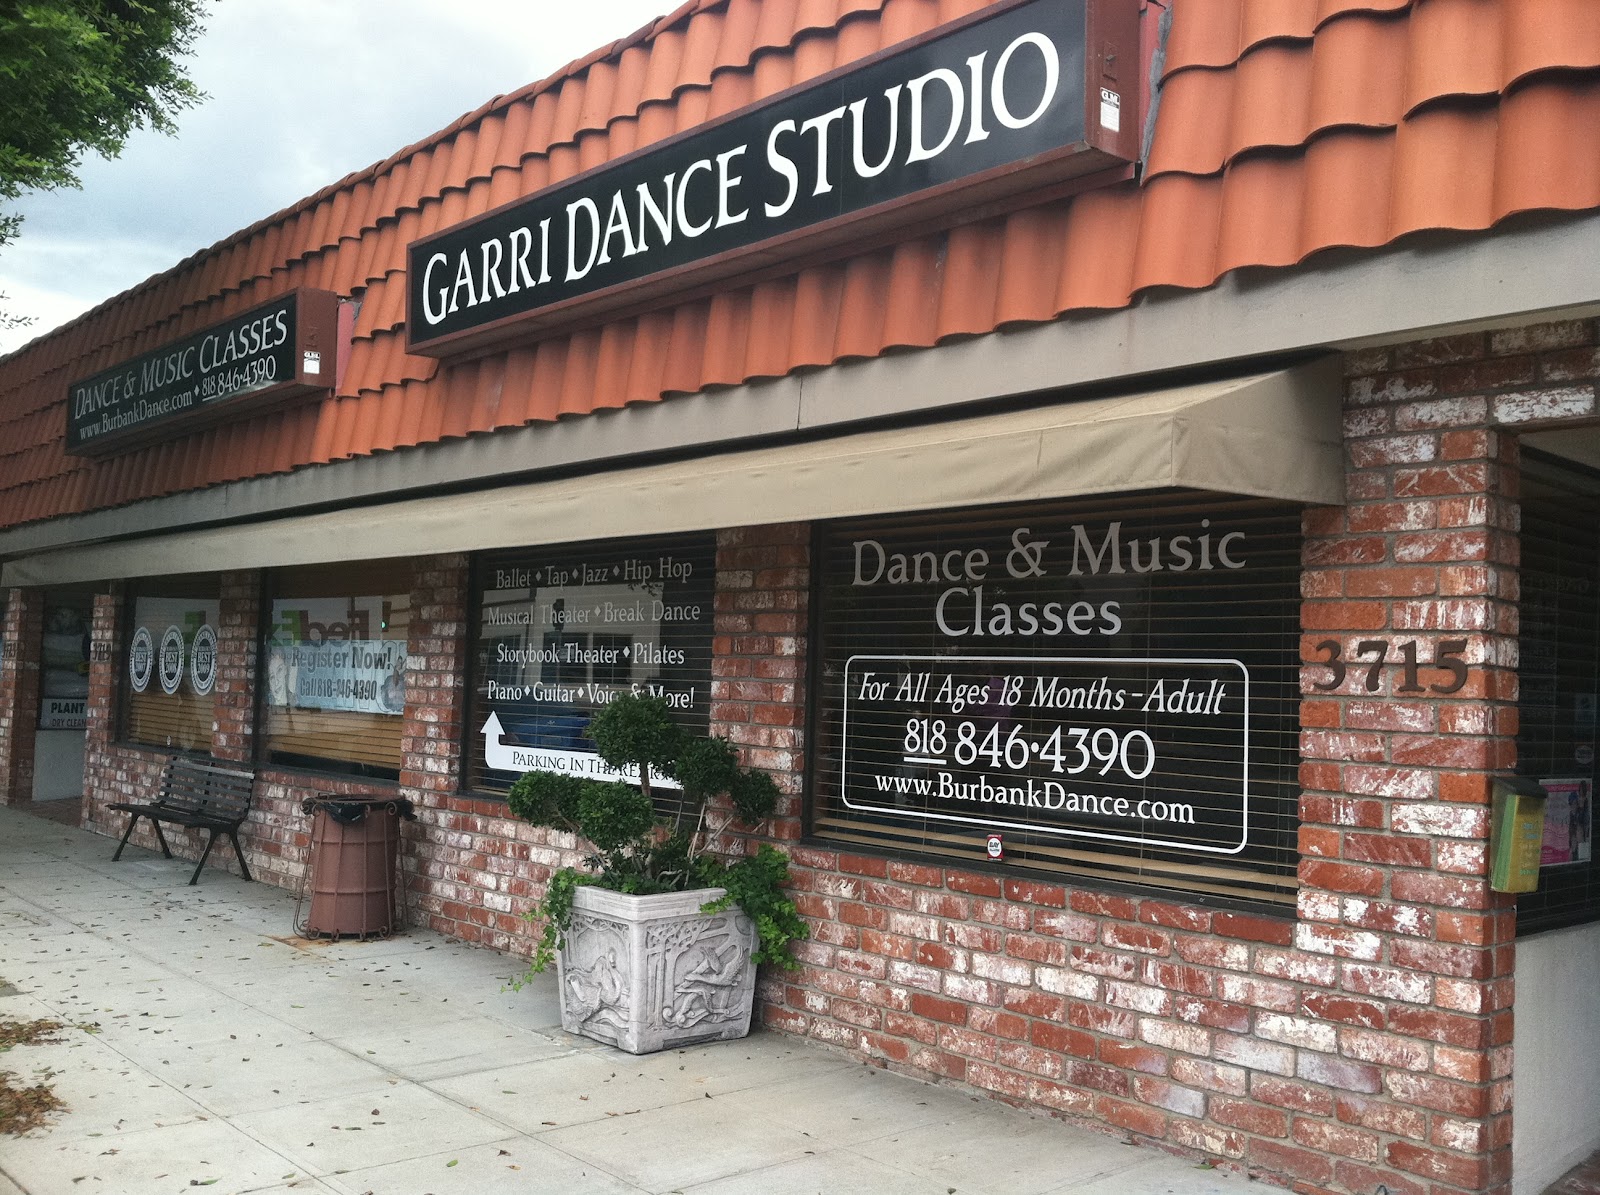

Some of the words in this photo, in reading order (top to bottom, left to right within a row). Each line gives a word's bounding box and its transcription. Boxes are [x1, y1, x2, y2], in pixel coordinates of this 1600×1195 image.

[421, 217, 552, 326] GARRI
[563, 144, 749, 283] DANCE
[764, 31, 1060, 219] STUDIO
[75, 373, 122, 420] DANCE
[123, 371, 137, 399] &
[139, 346, 195, 396] MUSIC
[199, 309, 288, 373] CLASSES
[79, 389, 193, 440] www.BurbankDance.com
[202, 376, 217, 401] 818
[852, 539, 990, 586] Dance
[1006, 527, 1050, 578] &
[1069, 519, 1247, 576] Music
[495, 568, 532, 589] Ballet
[545, 564, 569, 590] Tap
[582, 563, 609, 587] Jazz
[623, 559, 652, 585] Hip
[658, 556, 693, 584] Hop
[487, 605, 534, 625] Musical
[540, 604, 591, 624] Theater
[603, 601, 645, 623] Break
[651, 600, 701, 621] Dance
[935, 586, 1123, 637] Classes
[135, 651, 147, 662] BEST
[165, 651, 179, 662] BEST
[197, 651, 212, 662] BEST
[291, 647, 349, 674] Register
[351, 647, 392, 670] Now!
[497, 643, 560, 669] Storybook
[564, 642, 619, 664] Theater
[633, 642, 685, 664] Pilates
[1313, 640, 1470, 694] 3715
[300, 676, 317, 697] Call
[317, 679, 378, 701] 818-846-4390
[487, 680, 522, 700] Piano
[532, 682, 575, 703] Guitar
[587, 683, 623, 704] Voic
[630, 683, 646, 700] &
[649, 685, 695, 709] More!
[858, 672, 890, 701] For
[894, 672, 930, 703] All
[934, 674, 990, 714] Ages
[999, 675, 1023, 706] 18
[1029, 677, 1126, 711] Months
[51, 702, 85, 714] PLANT
[52, 718, 65, 727] DRY
[903, 718, 947, 765] 818
[512, 751, 565, 770] PARKING
[570, 757, 584, 772] IN
[619, 761, 662, 780] RER
[875, 772, 1195, 824] www.BurbankDance.com
